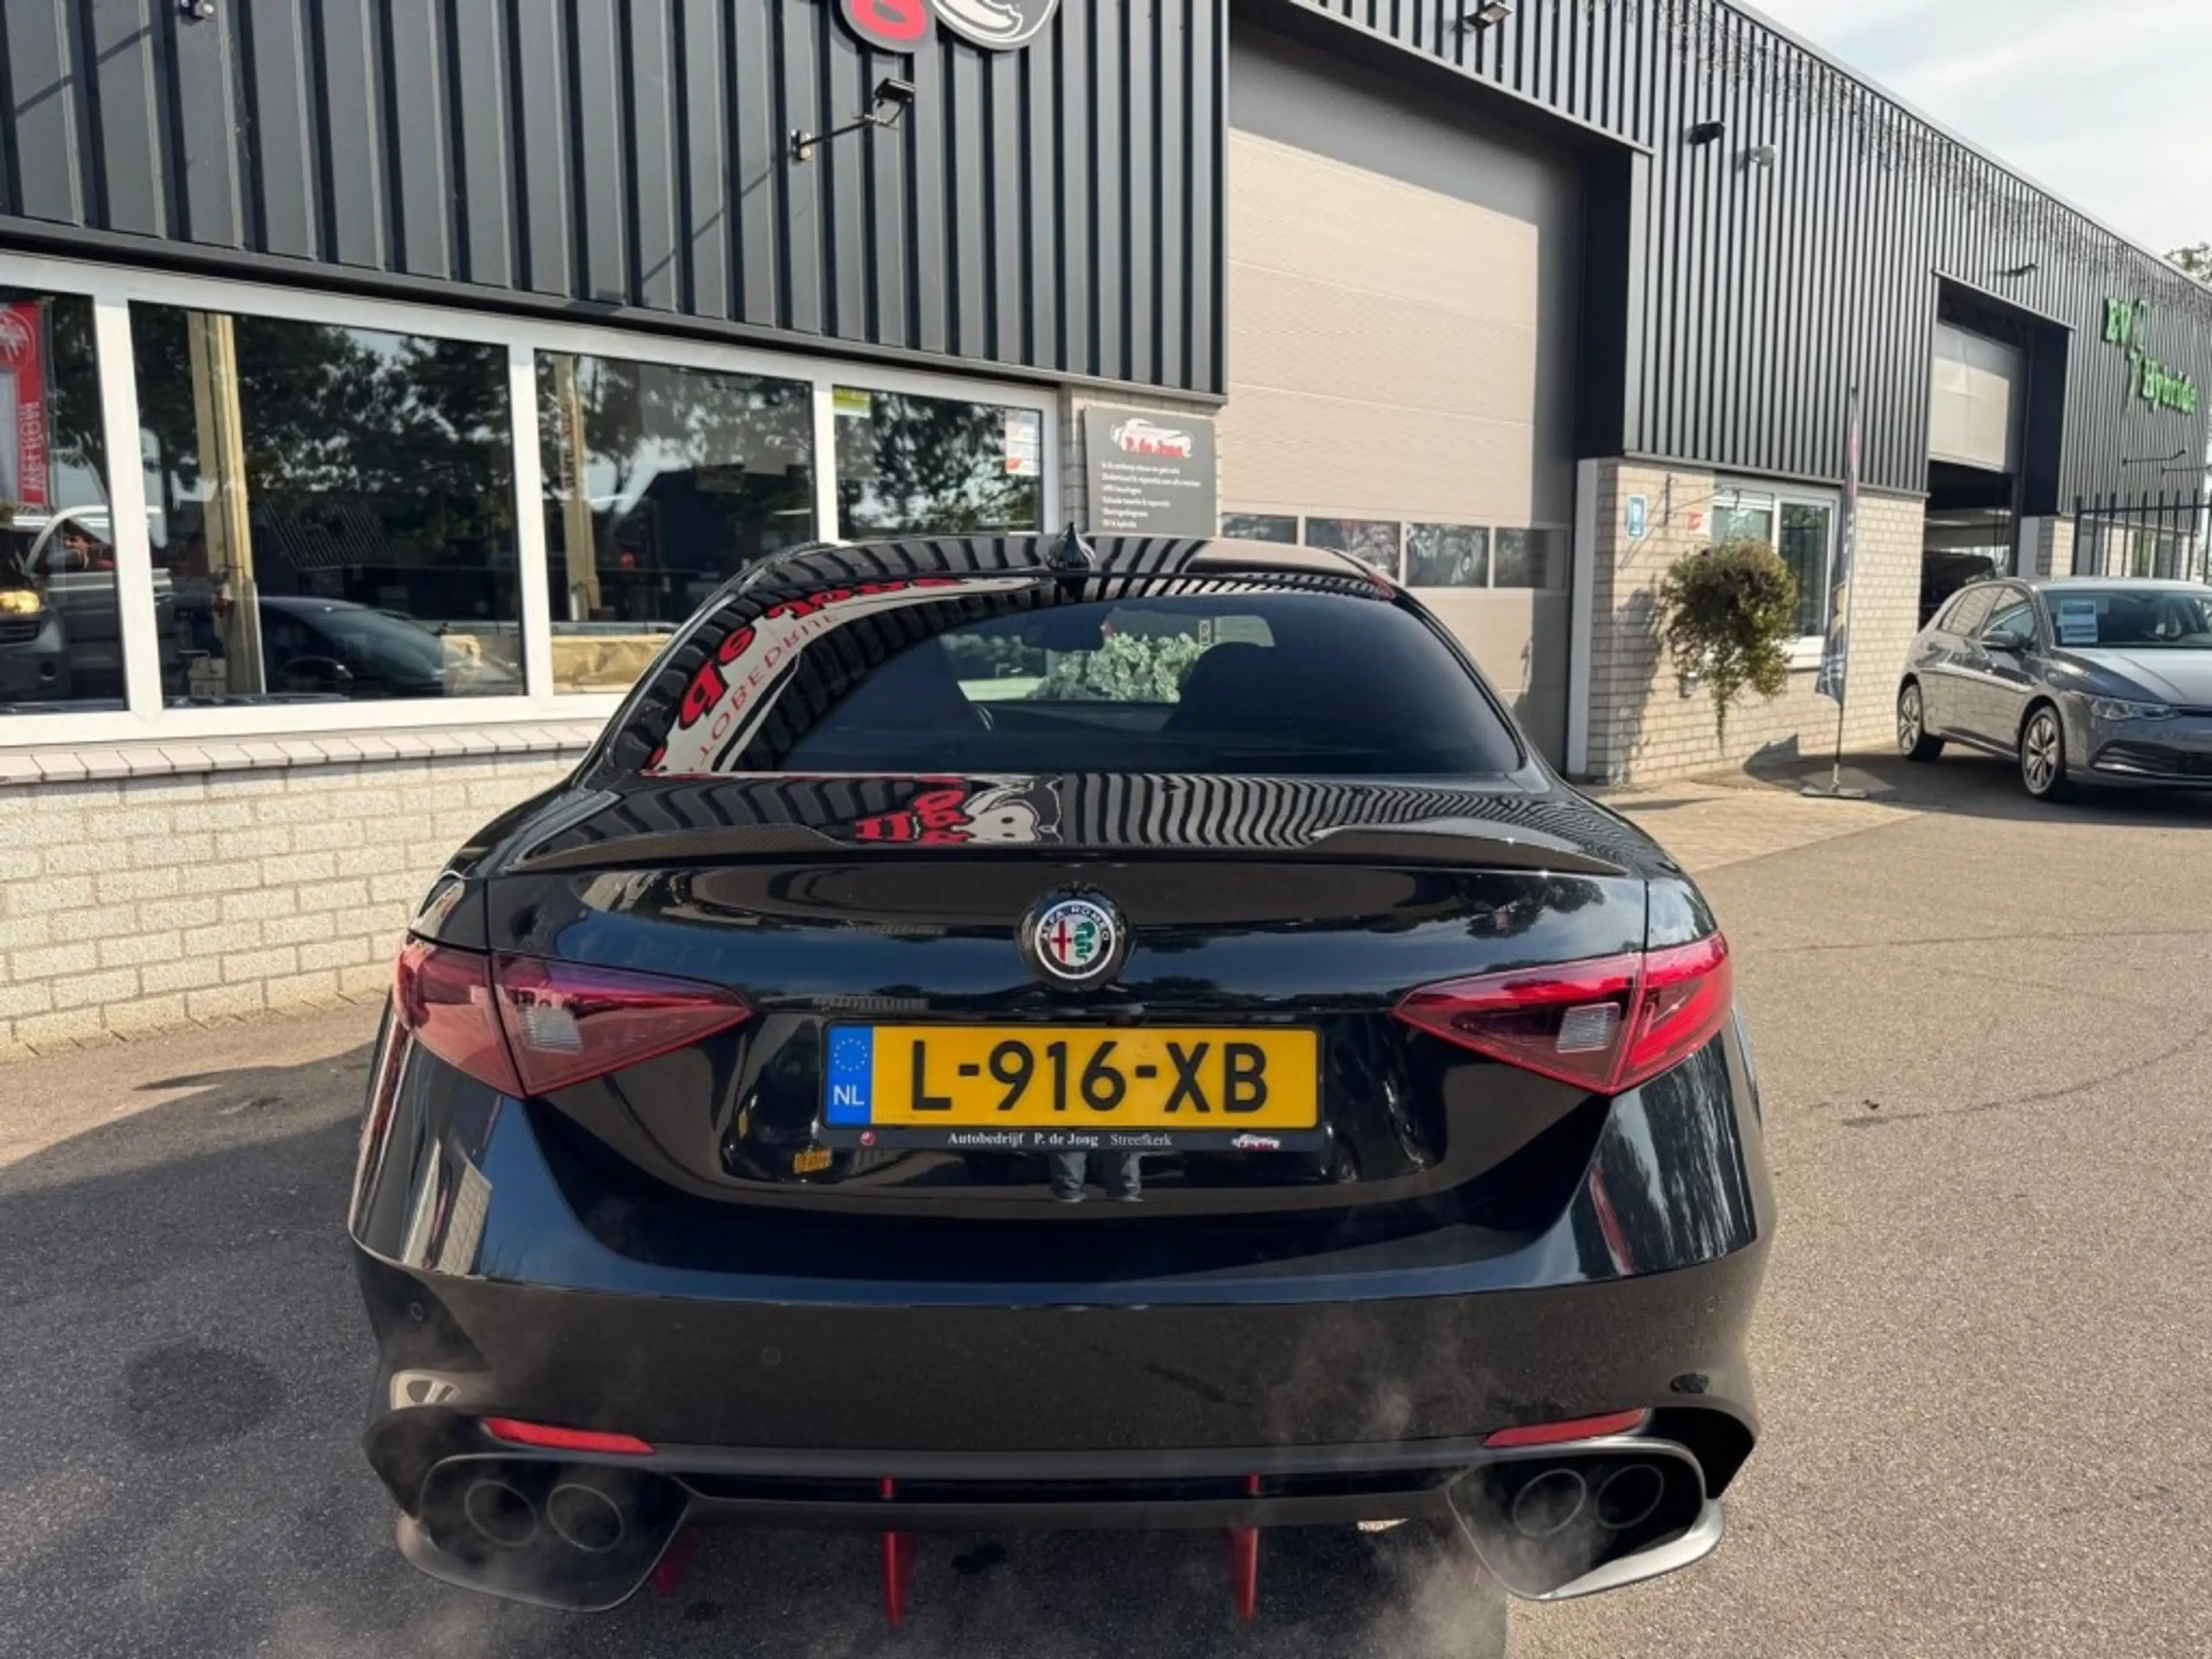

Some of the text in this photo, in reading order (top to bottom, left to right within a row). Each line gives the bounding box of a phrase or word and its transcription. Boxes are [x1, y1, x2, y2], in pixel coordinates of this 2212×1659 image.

[911, 1040, 1268, 1112] L-916-XB
[833, 1084, 865, 1106] NL
[948, 1132, 1173, 1147] Autobedrijf P. de Jong Streefkerk
